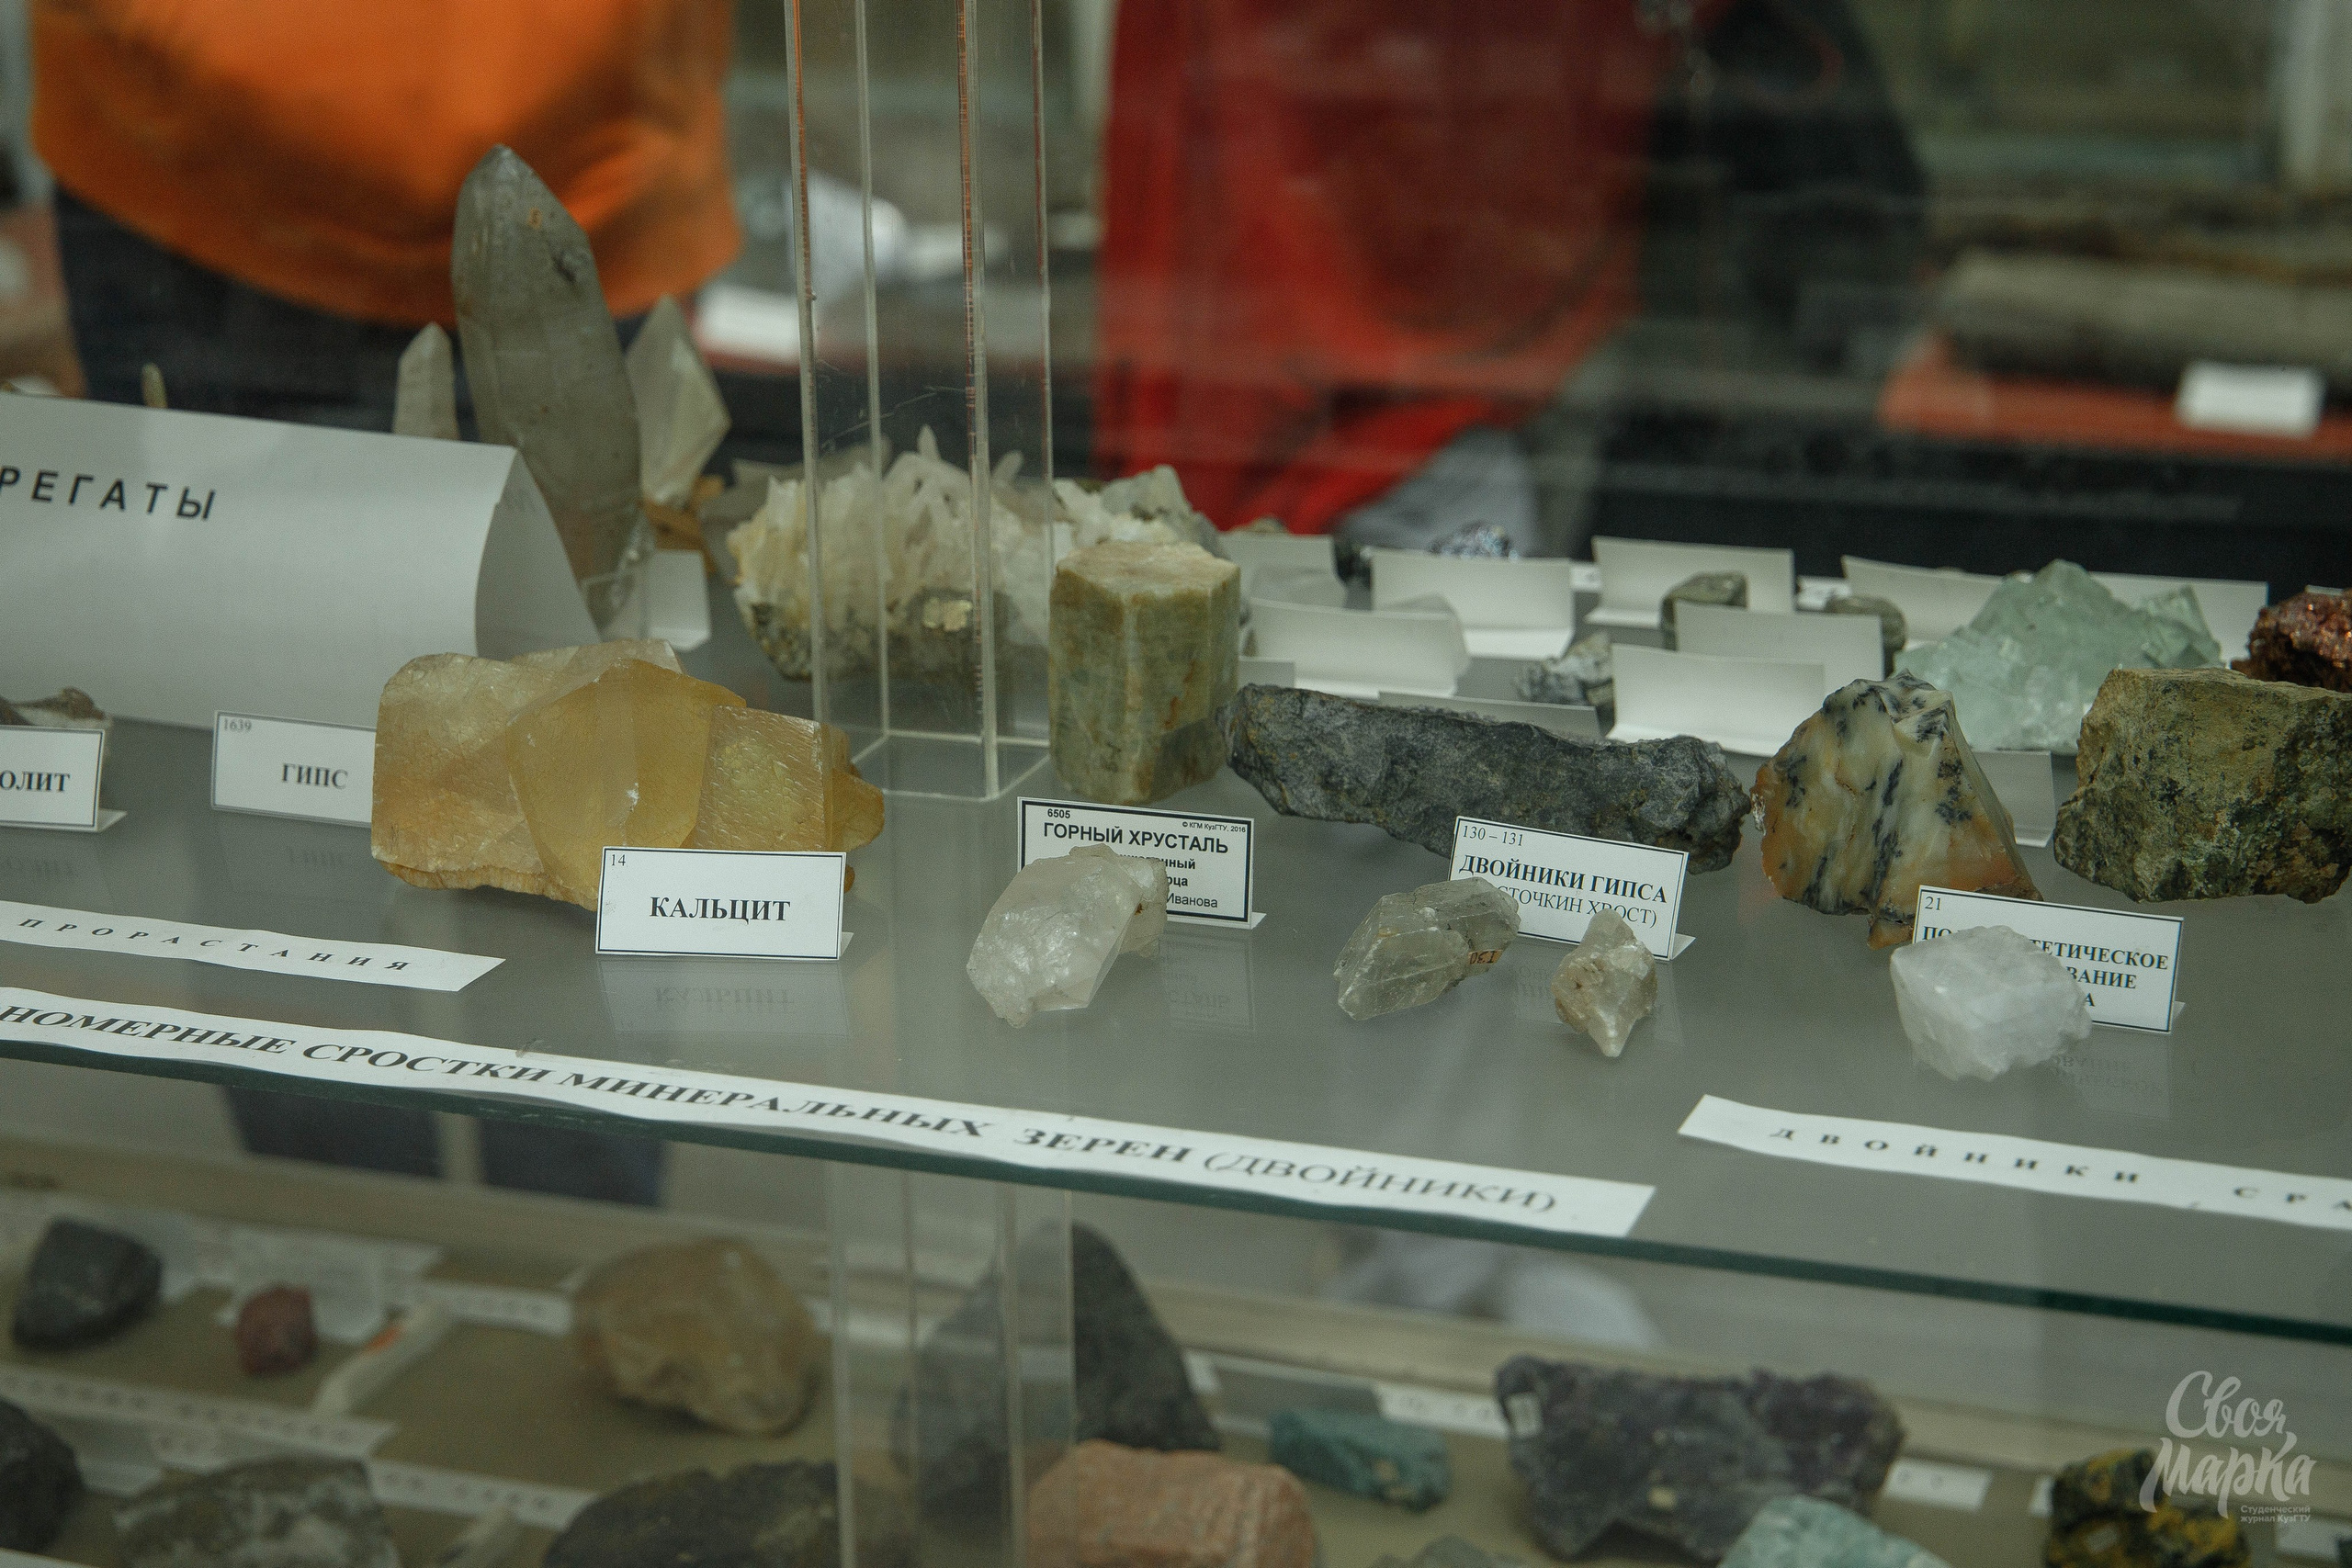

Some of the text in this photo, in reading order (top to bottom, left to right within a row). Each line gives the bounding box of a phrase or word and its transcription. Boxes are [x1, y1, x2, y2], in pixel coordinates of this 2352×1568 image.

[223, 717, 253, 732] 1639
[282, 762, 348, 790] ГИПС
[1047, 808, 1071, 819] 6505
[1189, 821, 1203, 829] КГМ
[1044, 822, 1229, 854] ГОРНЫЙ ХРУСТАЛЬ
[1463, 825, 1487, 840] 130
[1501, 830, 1524, 847] 131
[610, 853, 627, 867] 14
[1459, 854, 1668, 904] ДВОЙНИКИ ГИПСА
[649, 897, 791, 924] КАЛЬЦИТ
[1924, 897, 1941, 911] 21
[18, 918, 411, 971] ПРОРАСТАНИЯ
[302, 1043, 555, 1081] СРОСТКИ
[557, 1071, 993, 1137] МИНЕРАЛЬНЫХ
[1012, 1126, 1193, 1162] ЗЕРЕН
[1203, 1150, 1557, 1213] (ДВОЙНИКИ)
[1770, 1127, 2141, 1184] ДВОЙНИКИ
